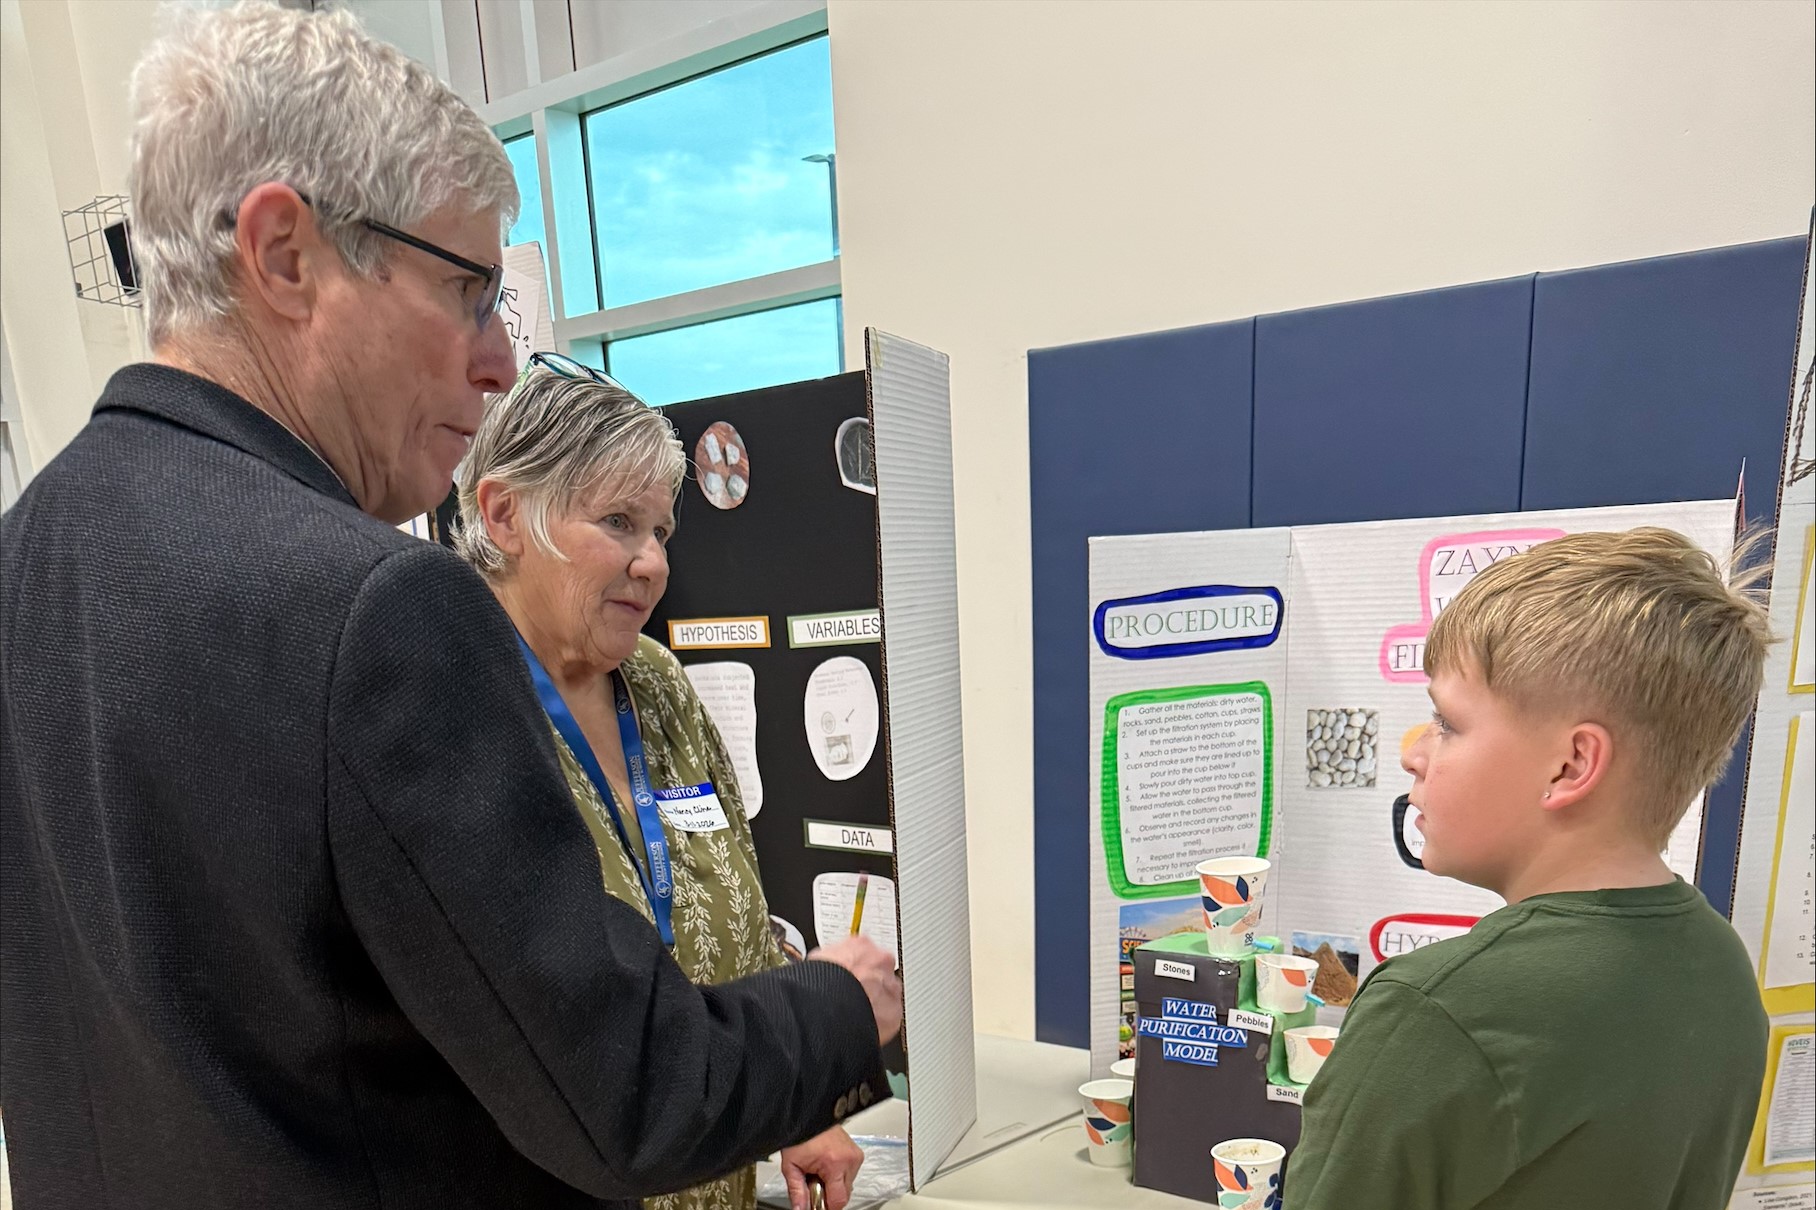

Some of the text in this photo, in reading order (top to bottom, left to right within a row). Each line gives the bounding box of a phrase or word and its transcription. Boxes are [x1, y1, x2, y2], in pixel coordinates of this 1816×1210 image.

[807, 617, 881, 639] VARIABLES
[1109, 604, 1273, 639] PROCEDURE
[681, 624, 758, 642] HYPOTHESIS
[1138, 706, 1163, 715] Gather
[1164, 704, 1172, 712] all
[1220, 698, 1234, 707] dirty
[1240, 706, 1260, 715] straws
[1136, 729, 1147, 737] Set
[1148, 730, 1158, 738] up
[1172, 724, 1199, 732] filtration
[1200, 721, 1223, 731] system
[1224, 719, 1234, 728] by
[1234, 717, 1260, 728] placing
[1139, 748, 1162, 758] Attach
[1170, 746, 1188, 754] straw
[1198, 743, 1209, 751] the
[1211, 741, 1236, 749] bottom
[1246, 738, 1257, 746] the
[1150, 738, 1161, 746] the
[1162, 734, 1193, 744] materials
[1202, 732, 1220, 740] each
[1126, 762, 1143, 770] cups
[1144, 760, 1158, 768] and
[1160, 757, 1179, 766] make
[1180, 756, 1193, 764] sure
[1195, 754, 1210, 763] they
[1224, 751, 1241, 759] lined
[1242, 750, 1252, 758] up
[1150, 770, 1166, 779] pour
[1167, 768, 1180, 776] into
[1182, 766, 1193, 774] the
[1194, 766, 1208, 774] cup
[1209, 762, 1230, 771] below
[1139, 780, 1160, 790] Slowly
[1161, 780, 1176, 788] pour
[1177, 777, 1193, 786] dirty
[1194, 775, 1213, 784] water
[1214, 773, 1227, 781] into
[1228, 772, 1240, 780] top
[661, 786, 702, 799] VISITOR
[1140, 792, 1158, 800] Allow
[1160, 790, 1171, 798] the
[1172, 788, 1192, 796] water
[1201, 785, 1216, 794] pass
[1217, 782, 1243, 792] through
[1130, 803, 1153, 812] filtered
[1187, 796, 1220, 806] collecting
[1221, 793, 1232, 801] the
[1233, 790, 1257, 799] filtered
[1139, 823, 1167, 832] Observe
[1168, 820, 1182, 829] and
[1183, 818, 1206, 827] record
[1207, 817, 1219, 826] any
[1220, 812, 1250, 823] changes
[1152, 812, 1172, 820] water
[1180, 809, 1191, 817] the
[1192, 807, 1217, 815] bottom
[842, 829, 874, 847] DATA
[1130, 836, 1141, 844] the
[1168, 828, 1210, 840] appearance
[1150, 852, 1175, 862] Repeat
[1188, 847, 1215, 856] filtration
[1215, 844, 1238, 854] process
[1137, 863, 1169, 873] necessary
[1180, 860, 1200, 869] impro
[1153, 872, 1174, 881] Clean
[1175, 872, 1185, 880] up
[1162, 963, 1191, 976] Stones
[1166, 1000, 1217, 1019] WATER
[1235, 1014, 1270, 1029] Pebbles
[1139, 1018, 1248, 1044] PURIFICATION
[1165, 1043, 1219, 1063] MODEL
[1276, 1088, 1299, 1099] Sand
